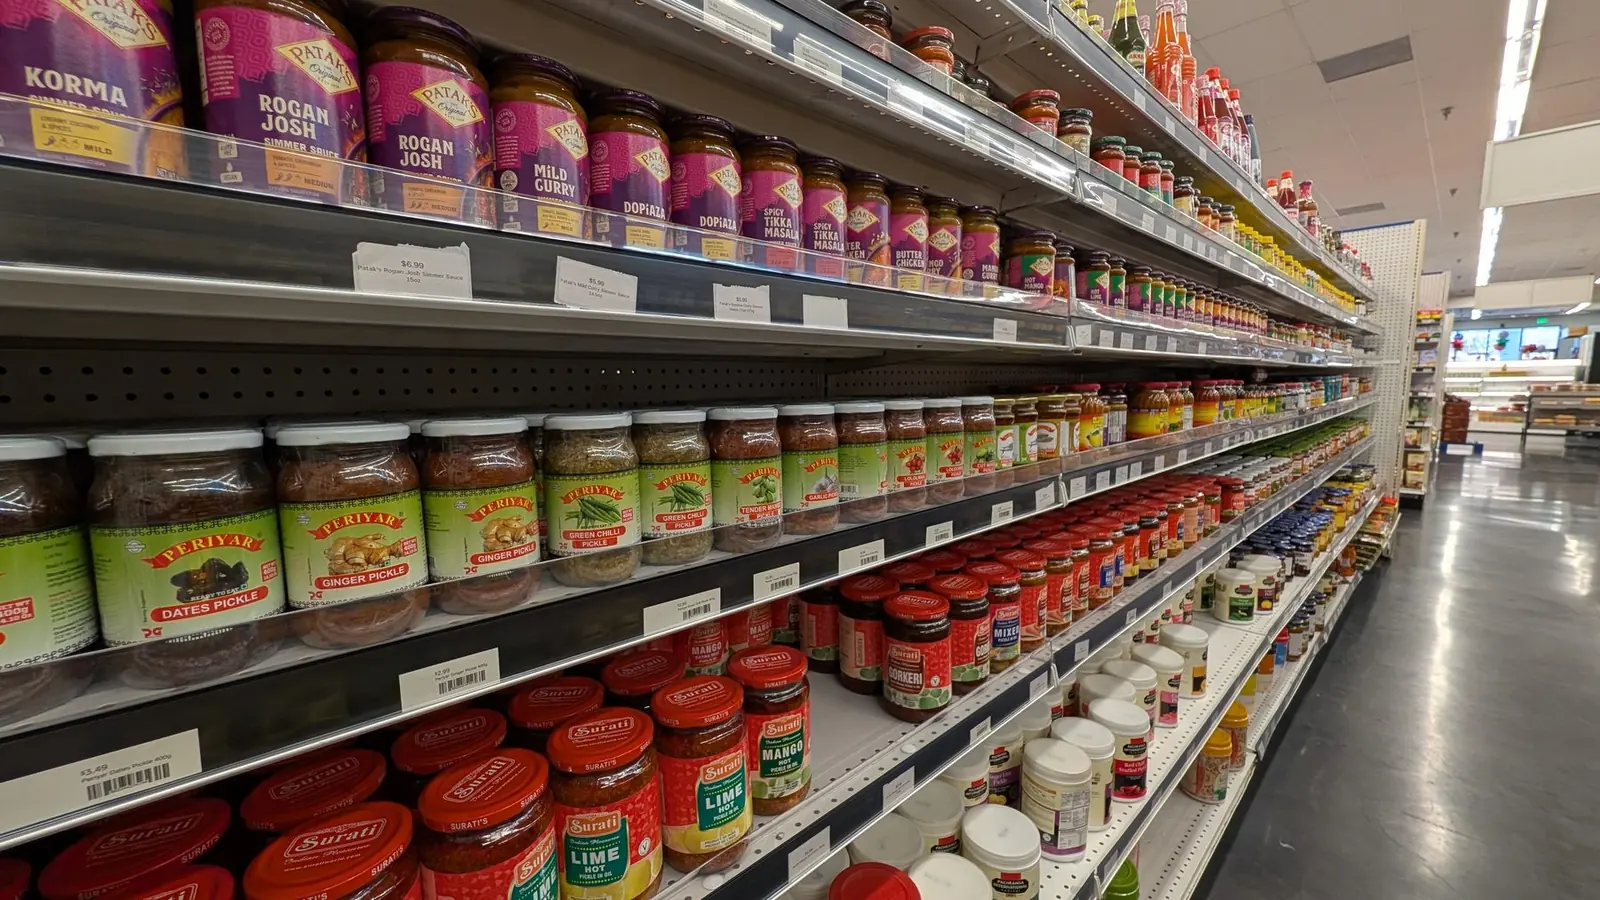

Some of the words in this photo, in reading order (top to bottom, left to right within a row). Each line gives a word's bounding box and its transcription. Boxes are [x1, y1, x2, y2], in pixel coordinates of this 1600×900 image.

[290, 45, 353, 86] PATAK'S
[24, 66, 128, 108] KORMA
[258, 94, 329, 125] ROGAN
[421, 87, 478, 118] PATAK'S
[261, 115, 317, 140] JOSH
[83, 143, 113, 155] MILD
[264, 137, 307, 152] SIMMER
[398, 134, 454, 156] ROGAN
[400, 150, 443, 170] JOSH
[534, 178, 575, 198] CURRY
[764, 228, 799, 240] MASALA
[814, 240, 844, 252] MASALA
[896, 250, 923, 259] BUTTER
[358, 264, 382, 272] Patak's
[384, 267, 404, 276] Rogan
[422, 271, 444, 279] Simmer
[401, 260, 425, 269] $6.99
[662, 473, 703, 487] PERIYAR
[568, 485, 617, 500] PERIYAR
[808, 493, 827, 501] GARLIC
[479, 497, 529, 517] PERIYAR
[741, 505, 768, 514] TENDER
[323, 513, 396, 535] PERIYAR
[569, 531, 595, 539] GREEN
[596, 528, 620, 537] CHILLI
[162, 534, 254, 562] PERIYAR
[582, 539, 608, 547] PICKLE
[477, 550, 512, 563] GINGER
[513, 542, 535, 556] PICKLE
[322, 575, 366, 587] GINGER
[369, 565, 405, 581] PICKLE
[191, 593, 214, 602] READY
[226, 587, 240, 595] EAT
[162, 603, 210, 620] DATES
[213, 590, 258, 610] PICKLE
[691, 641, 722, 655] MANGO
[890, 646, 918, 660] Surati
[745, 653, 786, 666] Surati
[765, 680, 788, 688] SURATI'S
[888, 666, 923, 685] GORKERI
[535, 687, 583, 698] Surati
[673, 683, 718, 701] Surati
[704, 711, 729, 724] SURATI'S
[574, 719, 629, 737] Surati
[767, 720, 800, 736] Surati
[762, 739, 803, 760] MANGO
[81, 771, 108, 783] Periyar
[109, 766, 131, 776] Dates
[132, 759, 153, 769] Pickle
[154, 754, 172, 762] 400g
[81, 763, 108, 776] $3.49
[585, 759, 617, 771] SURATI'S
[705, 756, 741, 780] Surati
[770, 765, 786, 773] PICKLE
[778, 757, 792, 766] HOT
[454, 760, 507, 799] Surati
[705, 782, 743, 810] LIME
[718, 801, 735, 813] HOT
[451, 817, 489, 830] SURATI'S
[570, 815, 617, 834] Surati
[713, 811, 729, 821] PICKLE
[101, 817, 194, 850] Surati
[295, 823, 378, 852] Surati
[181, 836, 219, 864] SURATI'S
[570, 846, 620, 865] LIME
[371, 845, 404, 877] SURATI'S
[584, 865, 606, 873] HOT
[532, 869, 557, 900] IME
